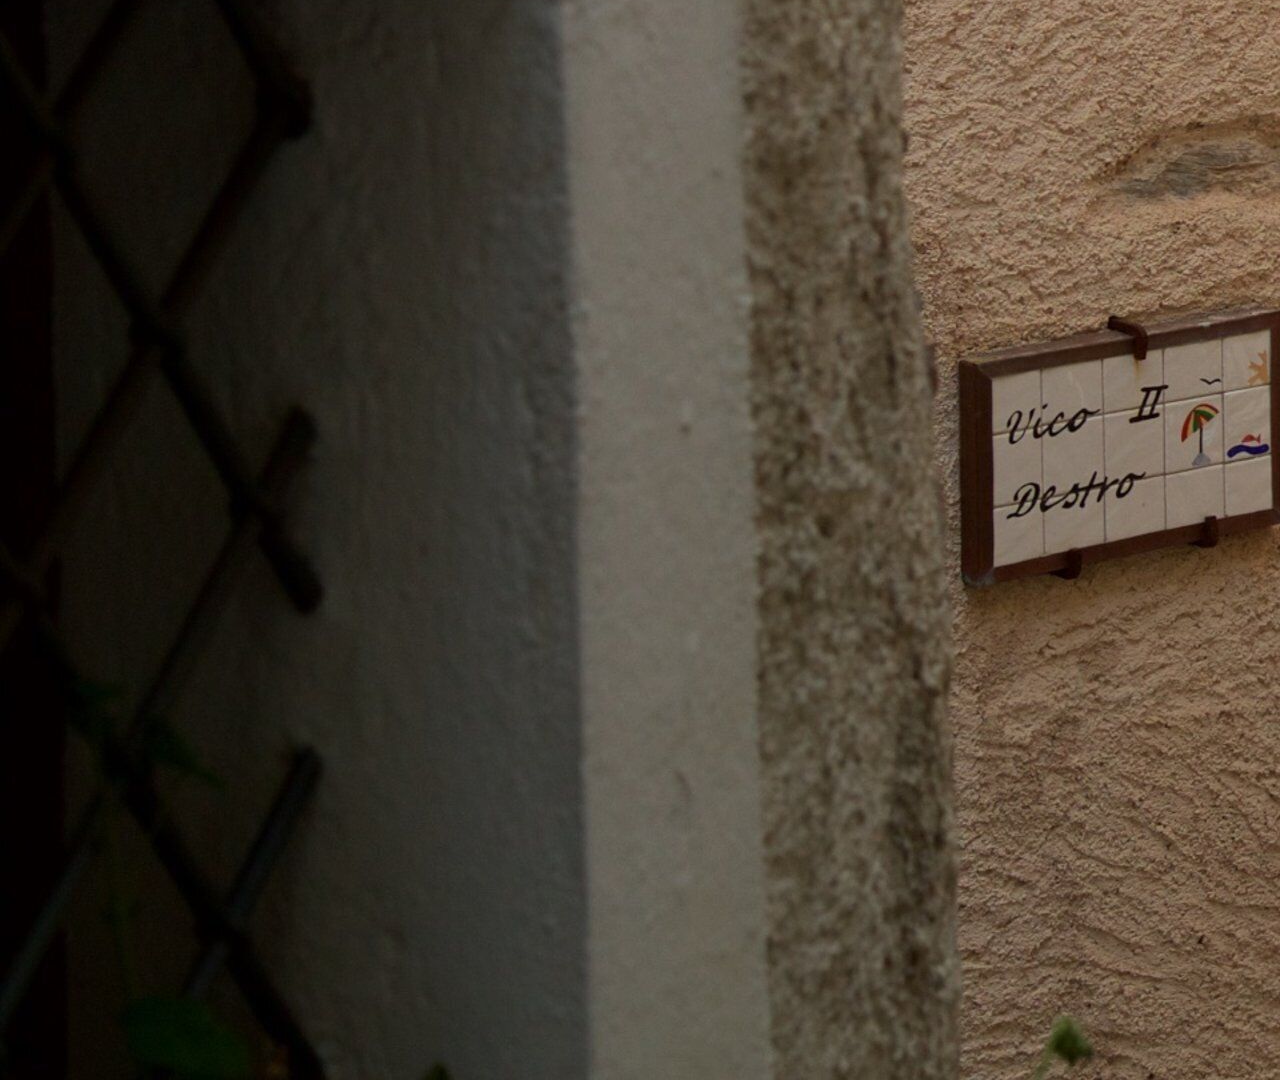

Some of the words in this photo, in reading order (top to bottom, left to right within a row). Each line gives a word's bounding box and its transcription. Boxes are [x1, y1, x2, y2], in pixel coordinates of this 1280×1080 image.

[1006, 404, 1101, 445] Vico
[1129, 384, 1169, 424] II
[1006, 470, 1147, 520] Destro
